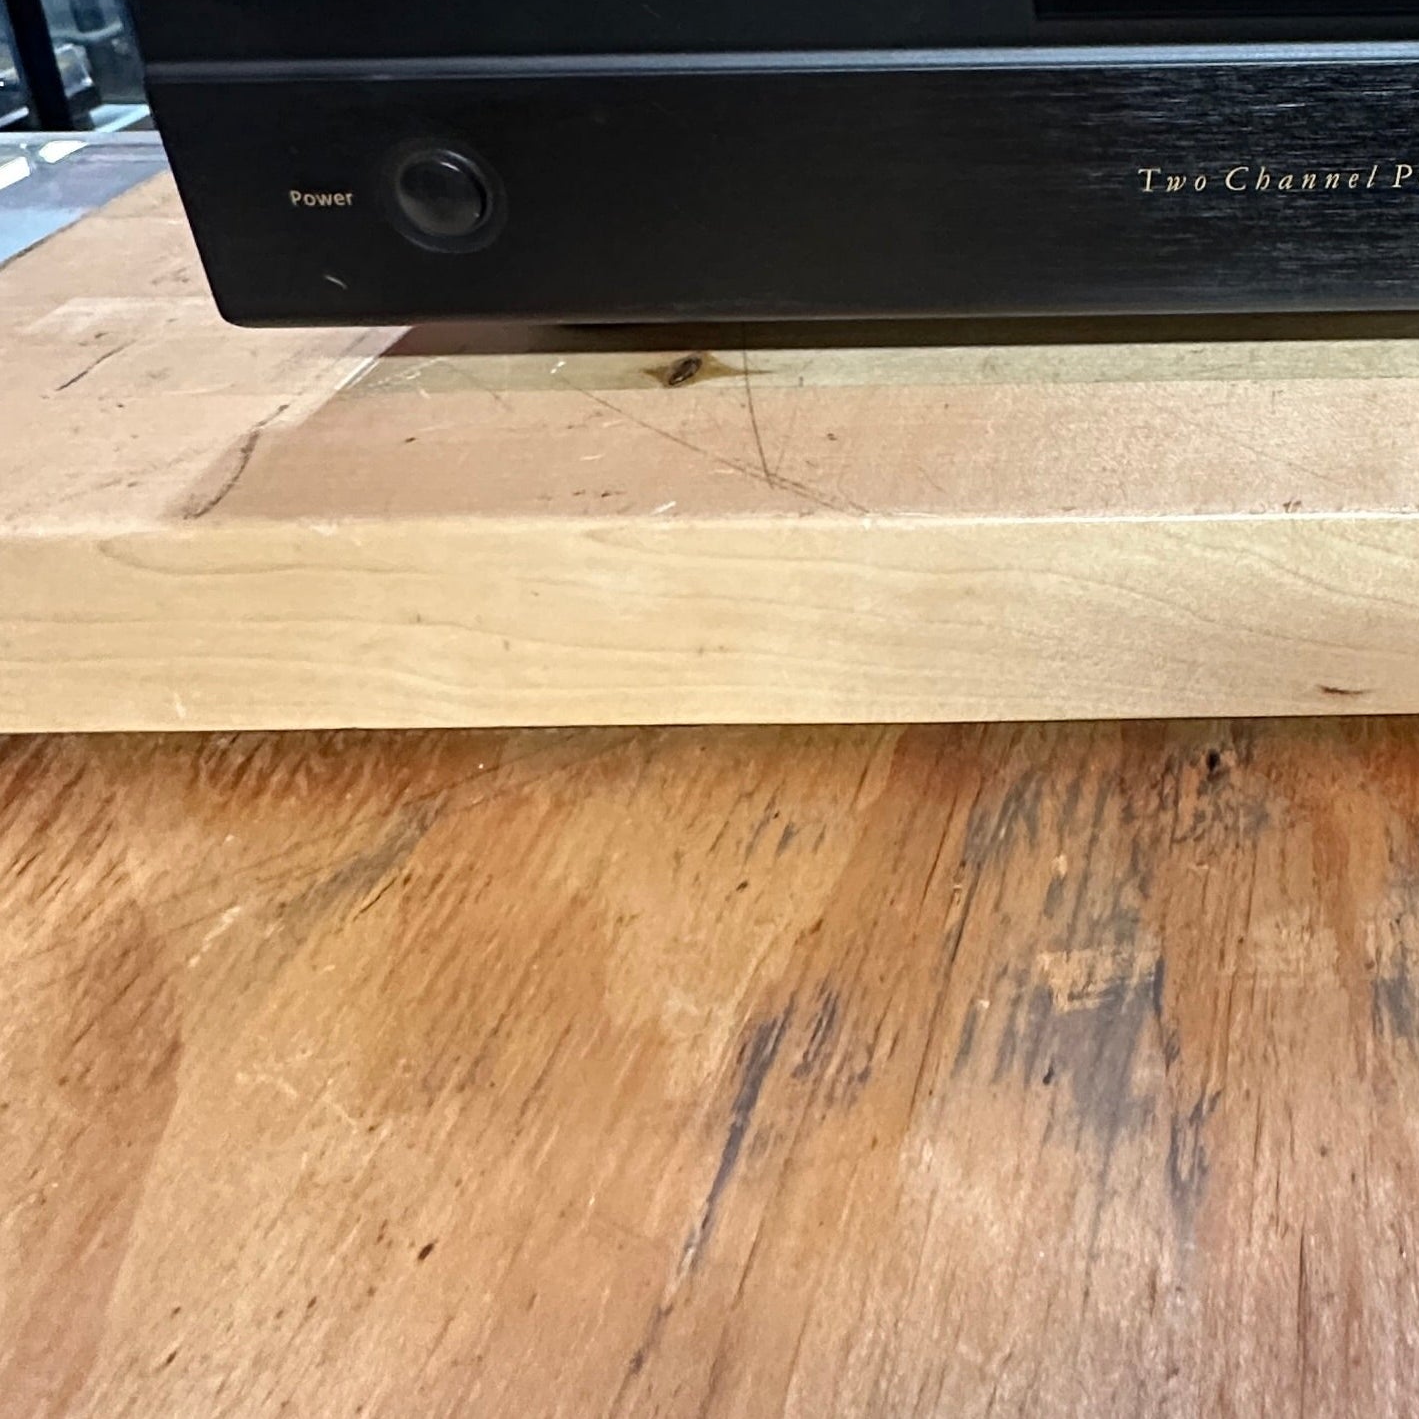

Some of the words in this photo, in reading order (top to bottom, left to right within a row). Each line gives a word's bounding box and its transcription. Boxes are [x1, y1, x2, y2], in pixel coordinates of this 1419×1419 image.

[1138, 168, 1208, 192] Two
[1224, 164, 1379, 192] Channel
[289, 190, 354, 207] Power
